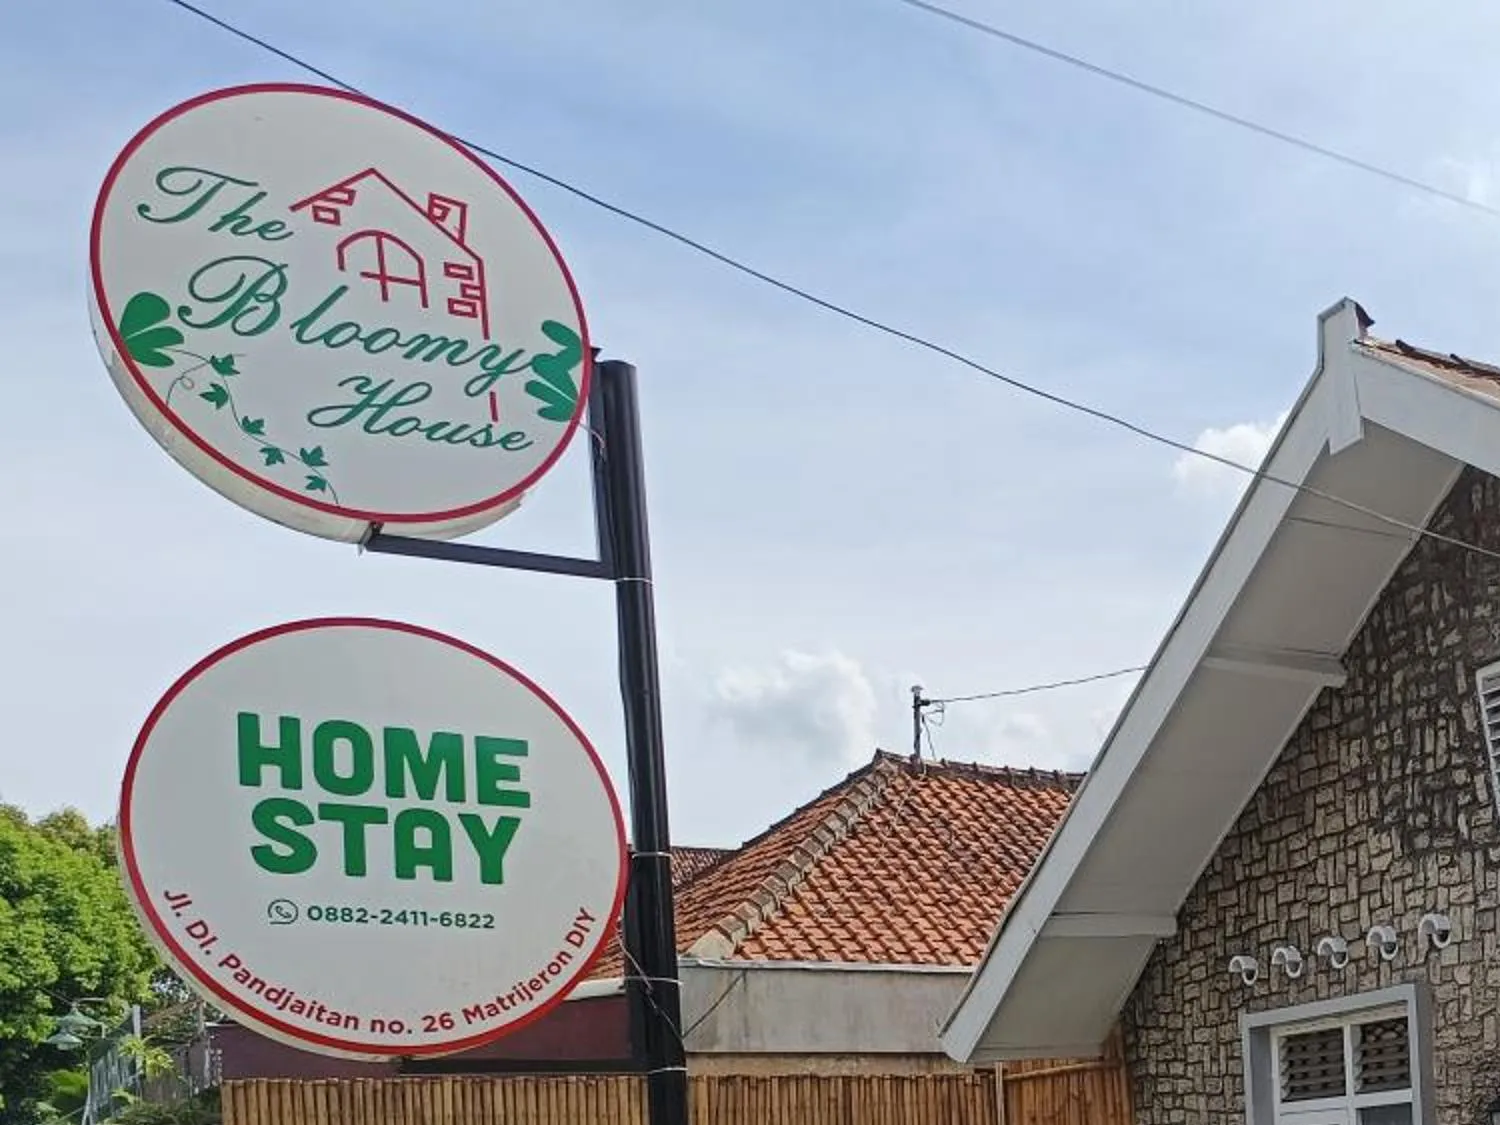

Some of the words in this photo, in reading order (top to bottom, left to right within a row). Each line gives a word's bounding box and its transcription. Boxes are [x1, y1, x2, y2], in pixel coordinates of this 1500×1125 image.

[136, 165, 294, 242] The
[177, 255, 540, 397] Bloomy
[307, 375, 534, 452] House
[237, 711, 531, 809] HOME
[250, 797, 522, 885] STAY
[307, 904, 495, 930] 0882-2411-6822
[218, 953, 360, 1032] Pandjaitan
[370, 1016, 413, 1035] no.
[422, 1012, 456, 1034] 26
[462, 950, 573, 1026] Matrijeron
[565, 906, 597, 949] DIY
